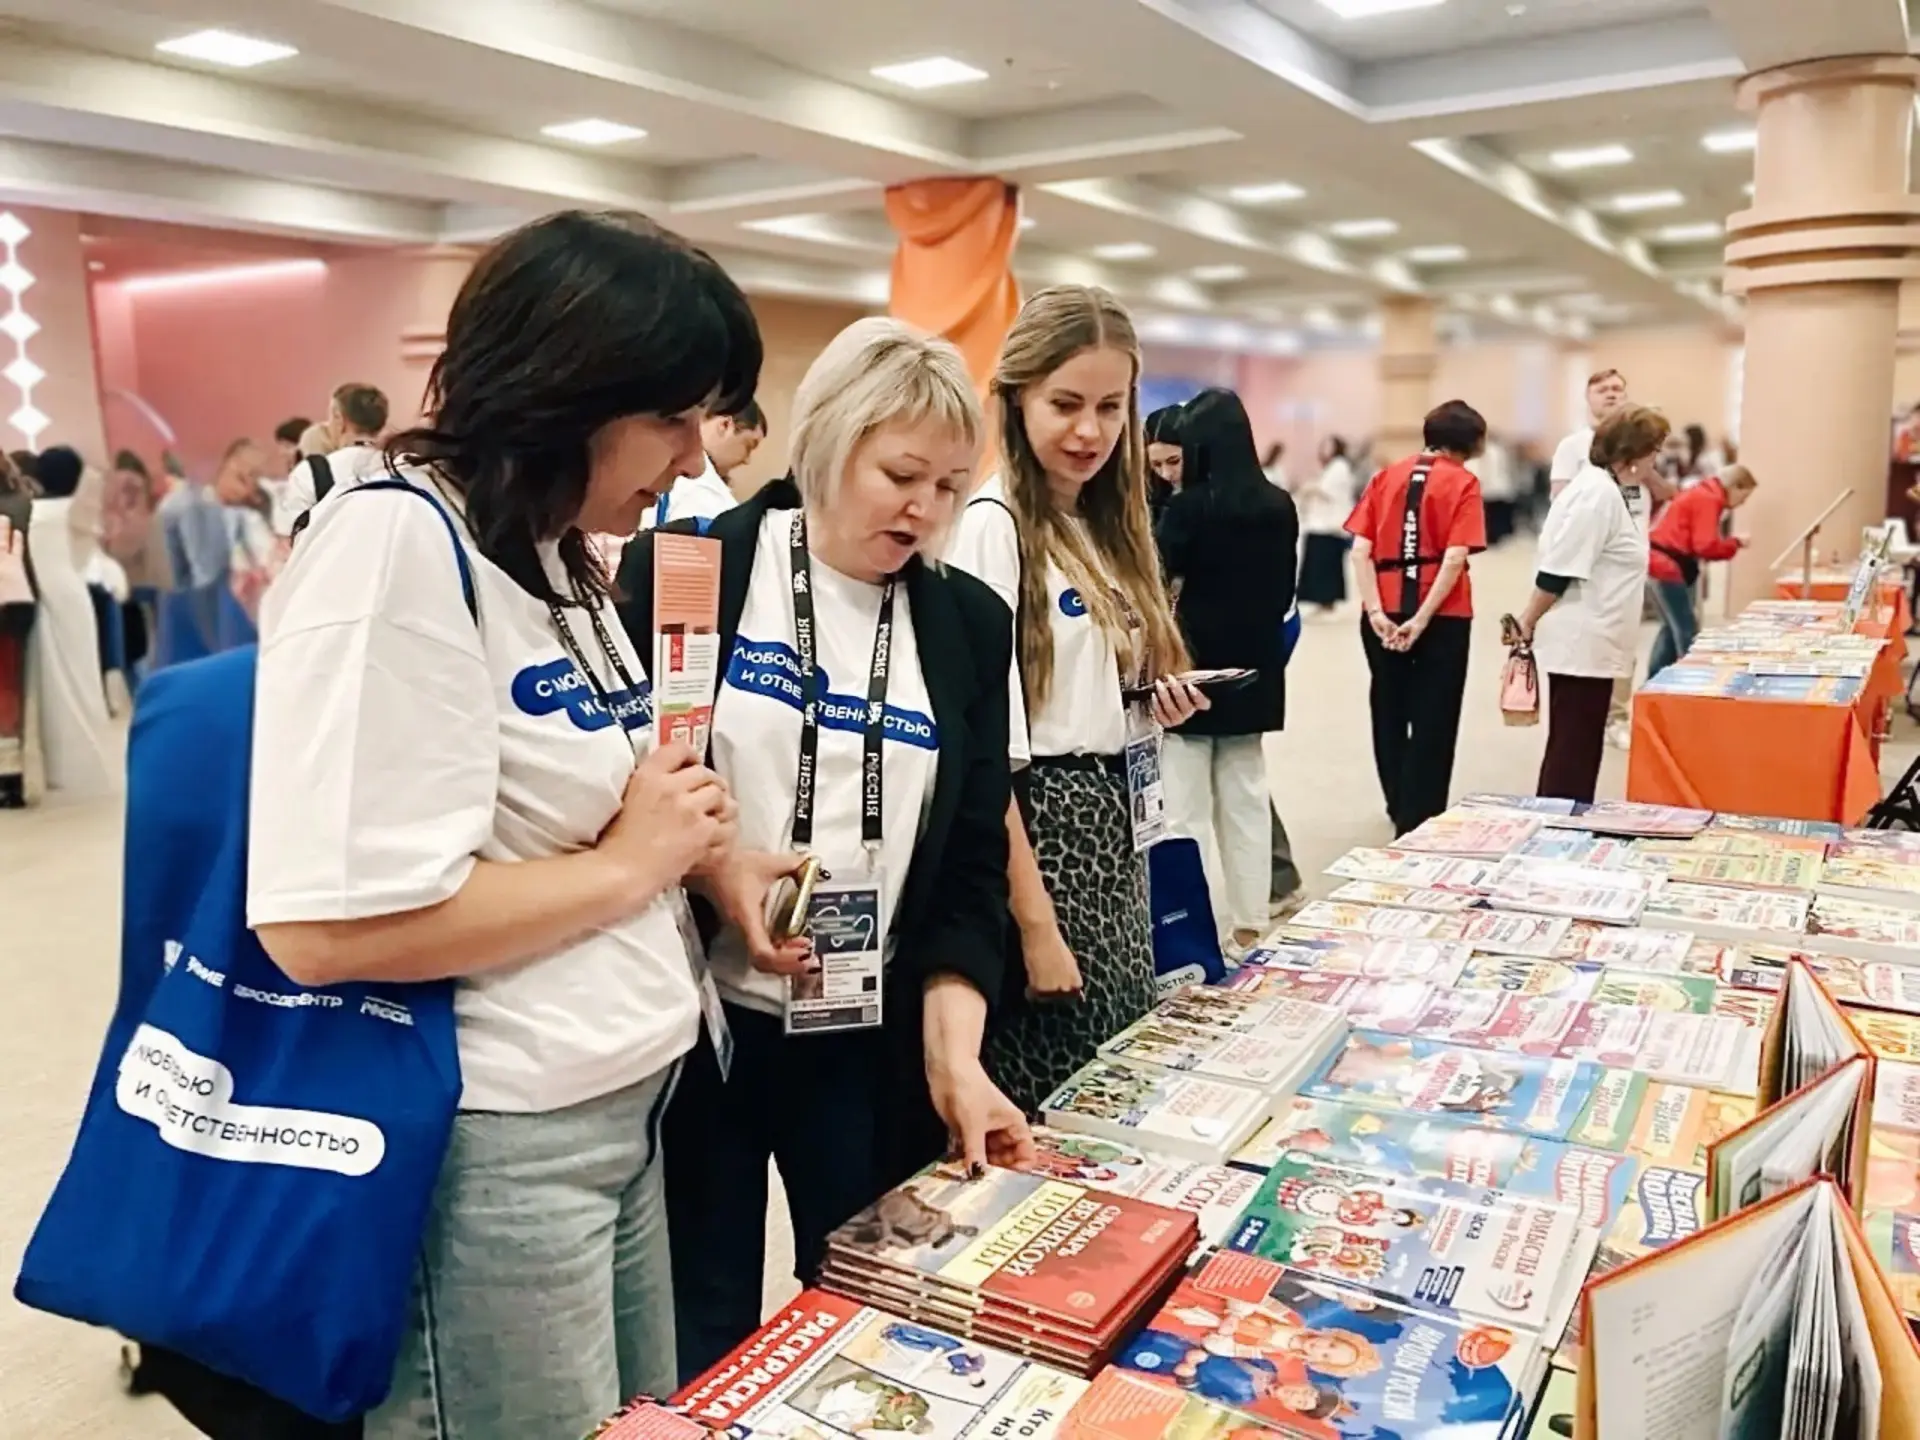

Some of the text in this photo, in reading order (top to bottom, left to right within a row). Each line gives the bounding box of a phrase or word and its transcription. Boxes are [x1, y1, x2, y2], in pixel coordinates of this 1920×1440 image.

[733, 647, 803, 678] ЛЮБОВЬ
[741, 669, 755, 682] И
[535, 680, 553, 697] С
[135, 1080, 151, 1098] И
[972, 1191, 1074, 1268] ПОБЕДЫ
[1000, 1198, 1102, 1277] ВЕЛИКОЙ
[1057, 1205, 1123, 1257] СЛОВАРЬ
[1514, 1207, 1557, 1277] РОМЫСЛЫ
[698, 1310, 840, 1420] РАСКРАСКА
[1019, 1408, 1054, 1437] Кто
